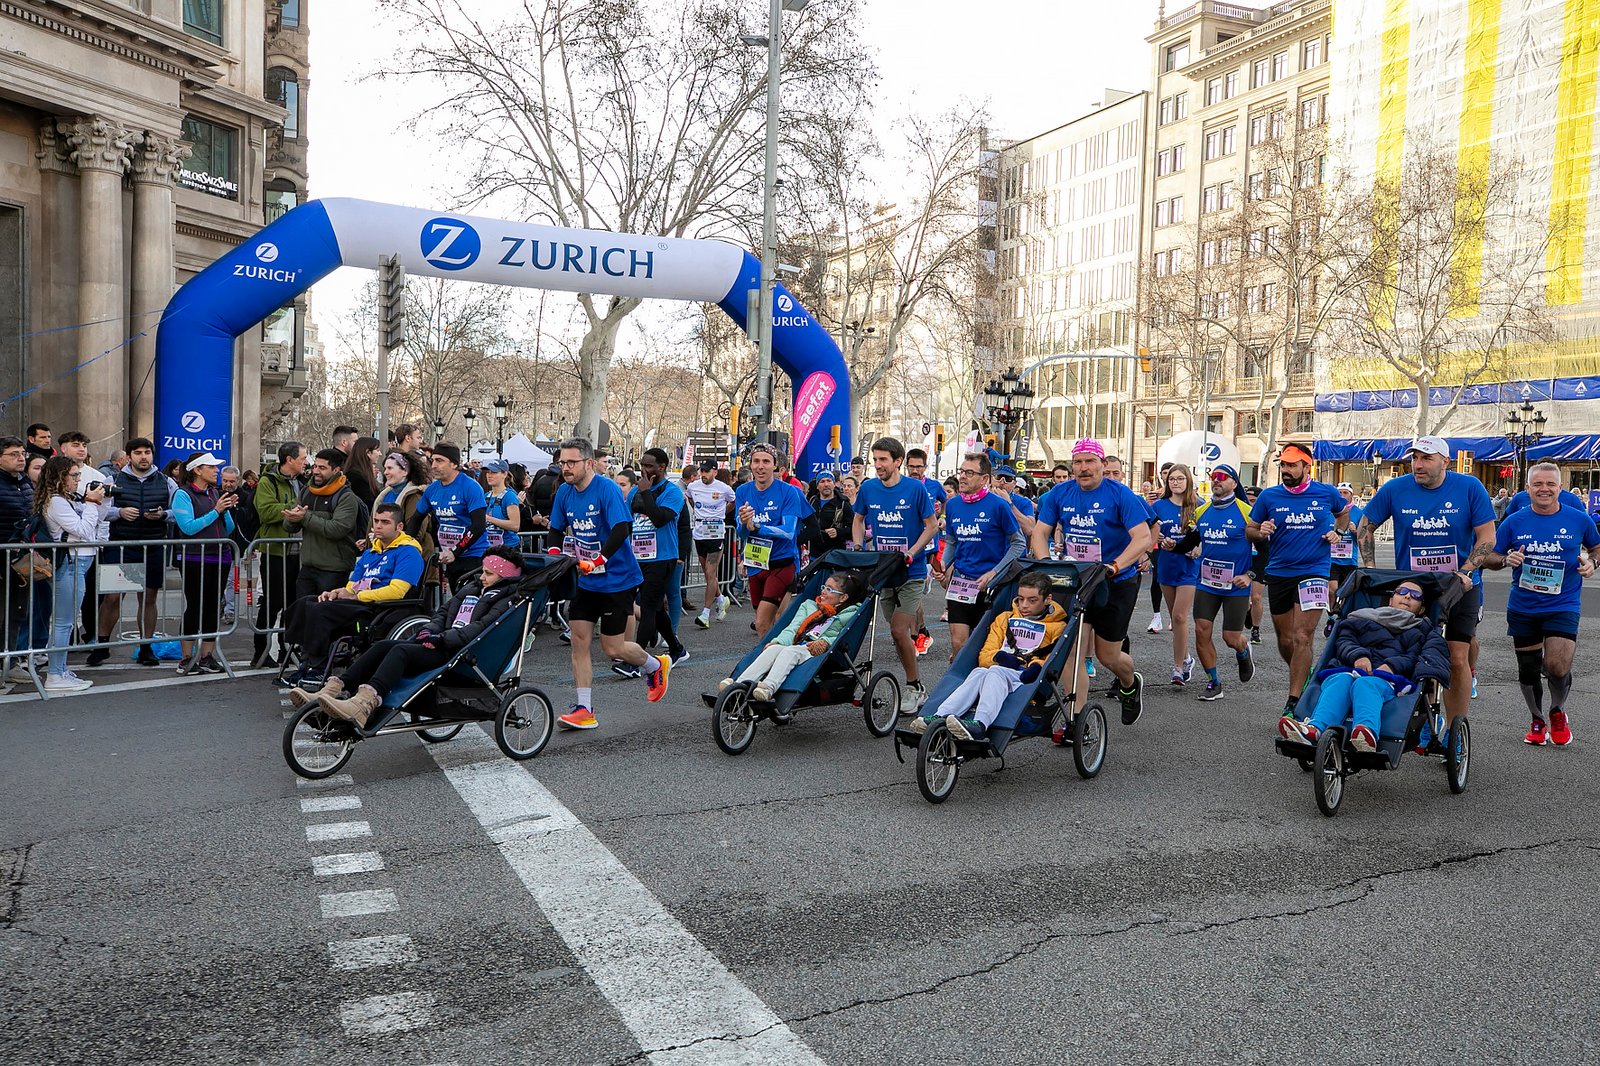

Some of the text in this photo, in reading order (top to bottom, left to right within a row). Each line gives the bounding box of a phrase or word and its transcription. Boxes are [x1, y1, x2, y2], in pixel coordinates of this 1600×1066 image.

[498, 236, 654, 278] ZURICH
[233, 265, 296, 283] ZURICH
[772, 316, 809, 327] URICH
[800, 381, 829, 426] aefat
[164, 436, 222, 450] ZURICH
[1416, 556, 1452, 566] GONZALO
[1210, 568, 1224, 576] FEDE
[1529, 566, 1554, 578] MANEL
[1307, 587, 1324, 595] FRAN
